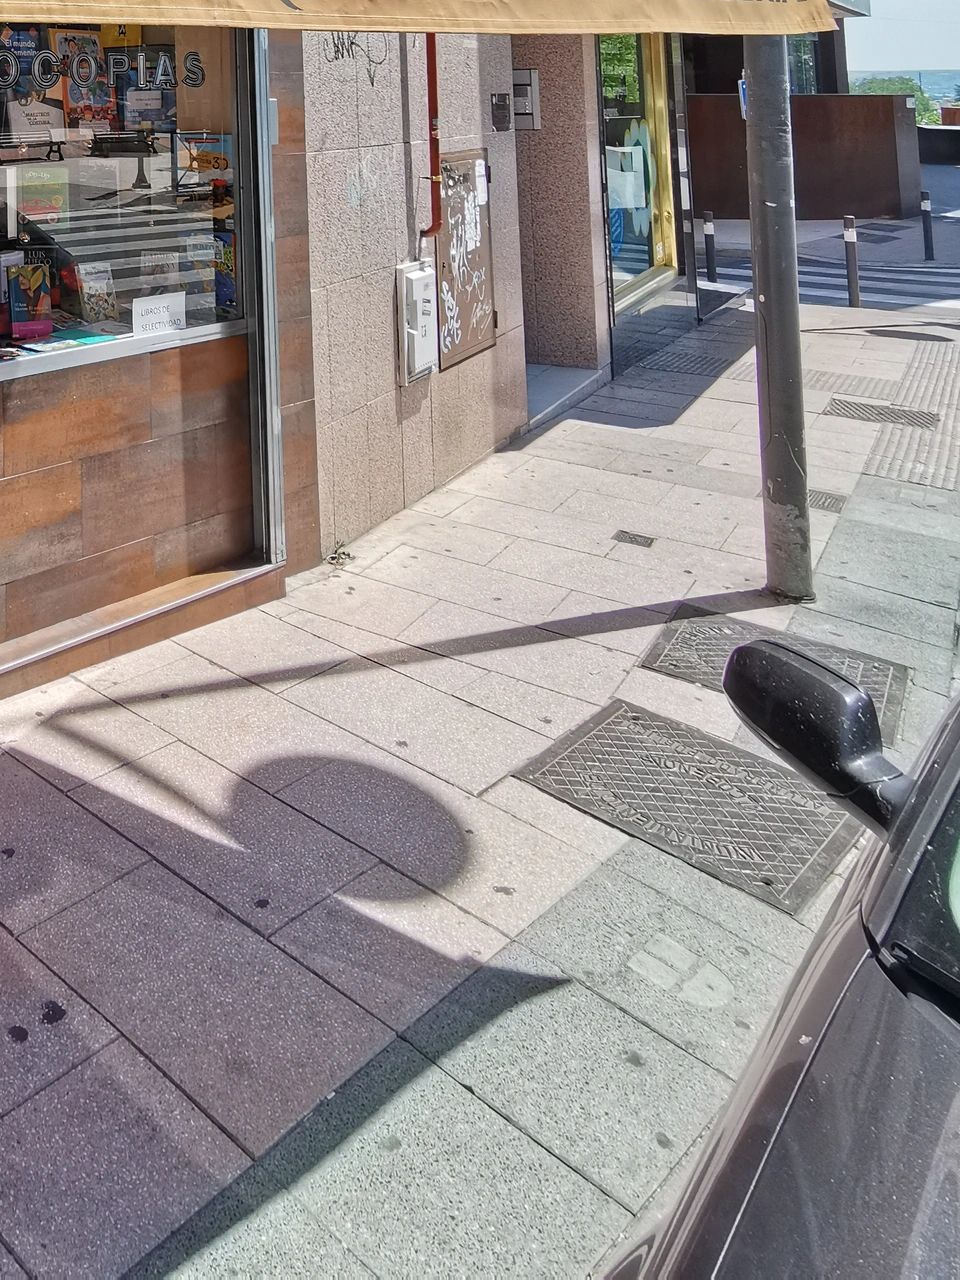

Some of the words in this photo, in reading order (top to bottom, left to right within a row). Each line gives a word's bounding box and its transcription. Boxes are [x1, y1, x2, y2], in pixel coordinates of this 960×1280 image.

[13, 40, 36, 48] mundo
[28, 250, 46, 259] LUIS
[140, 307, 162, 317] LIBROS
[162, 304, 171, 313] DE
